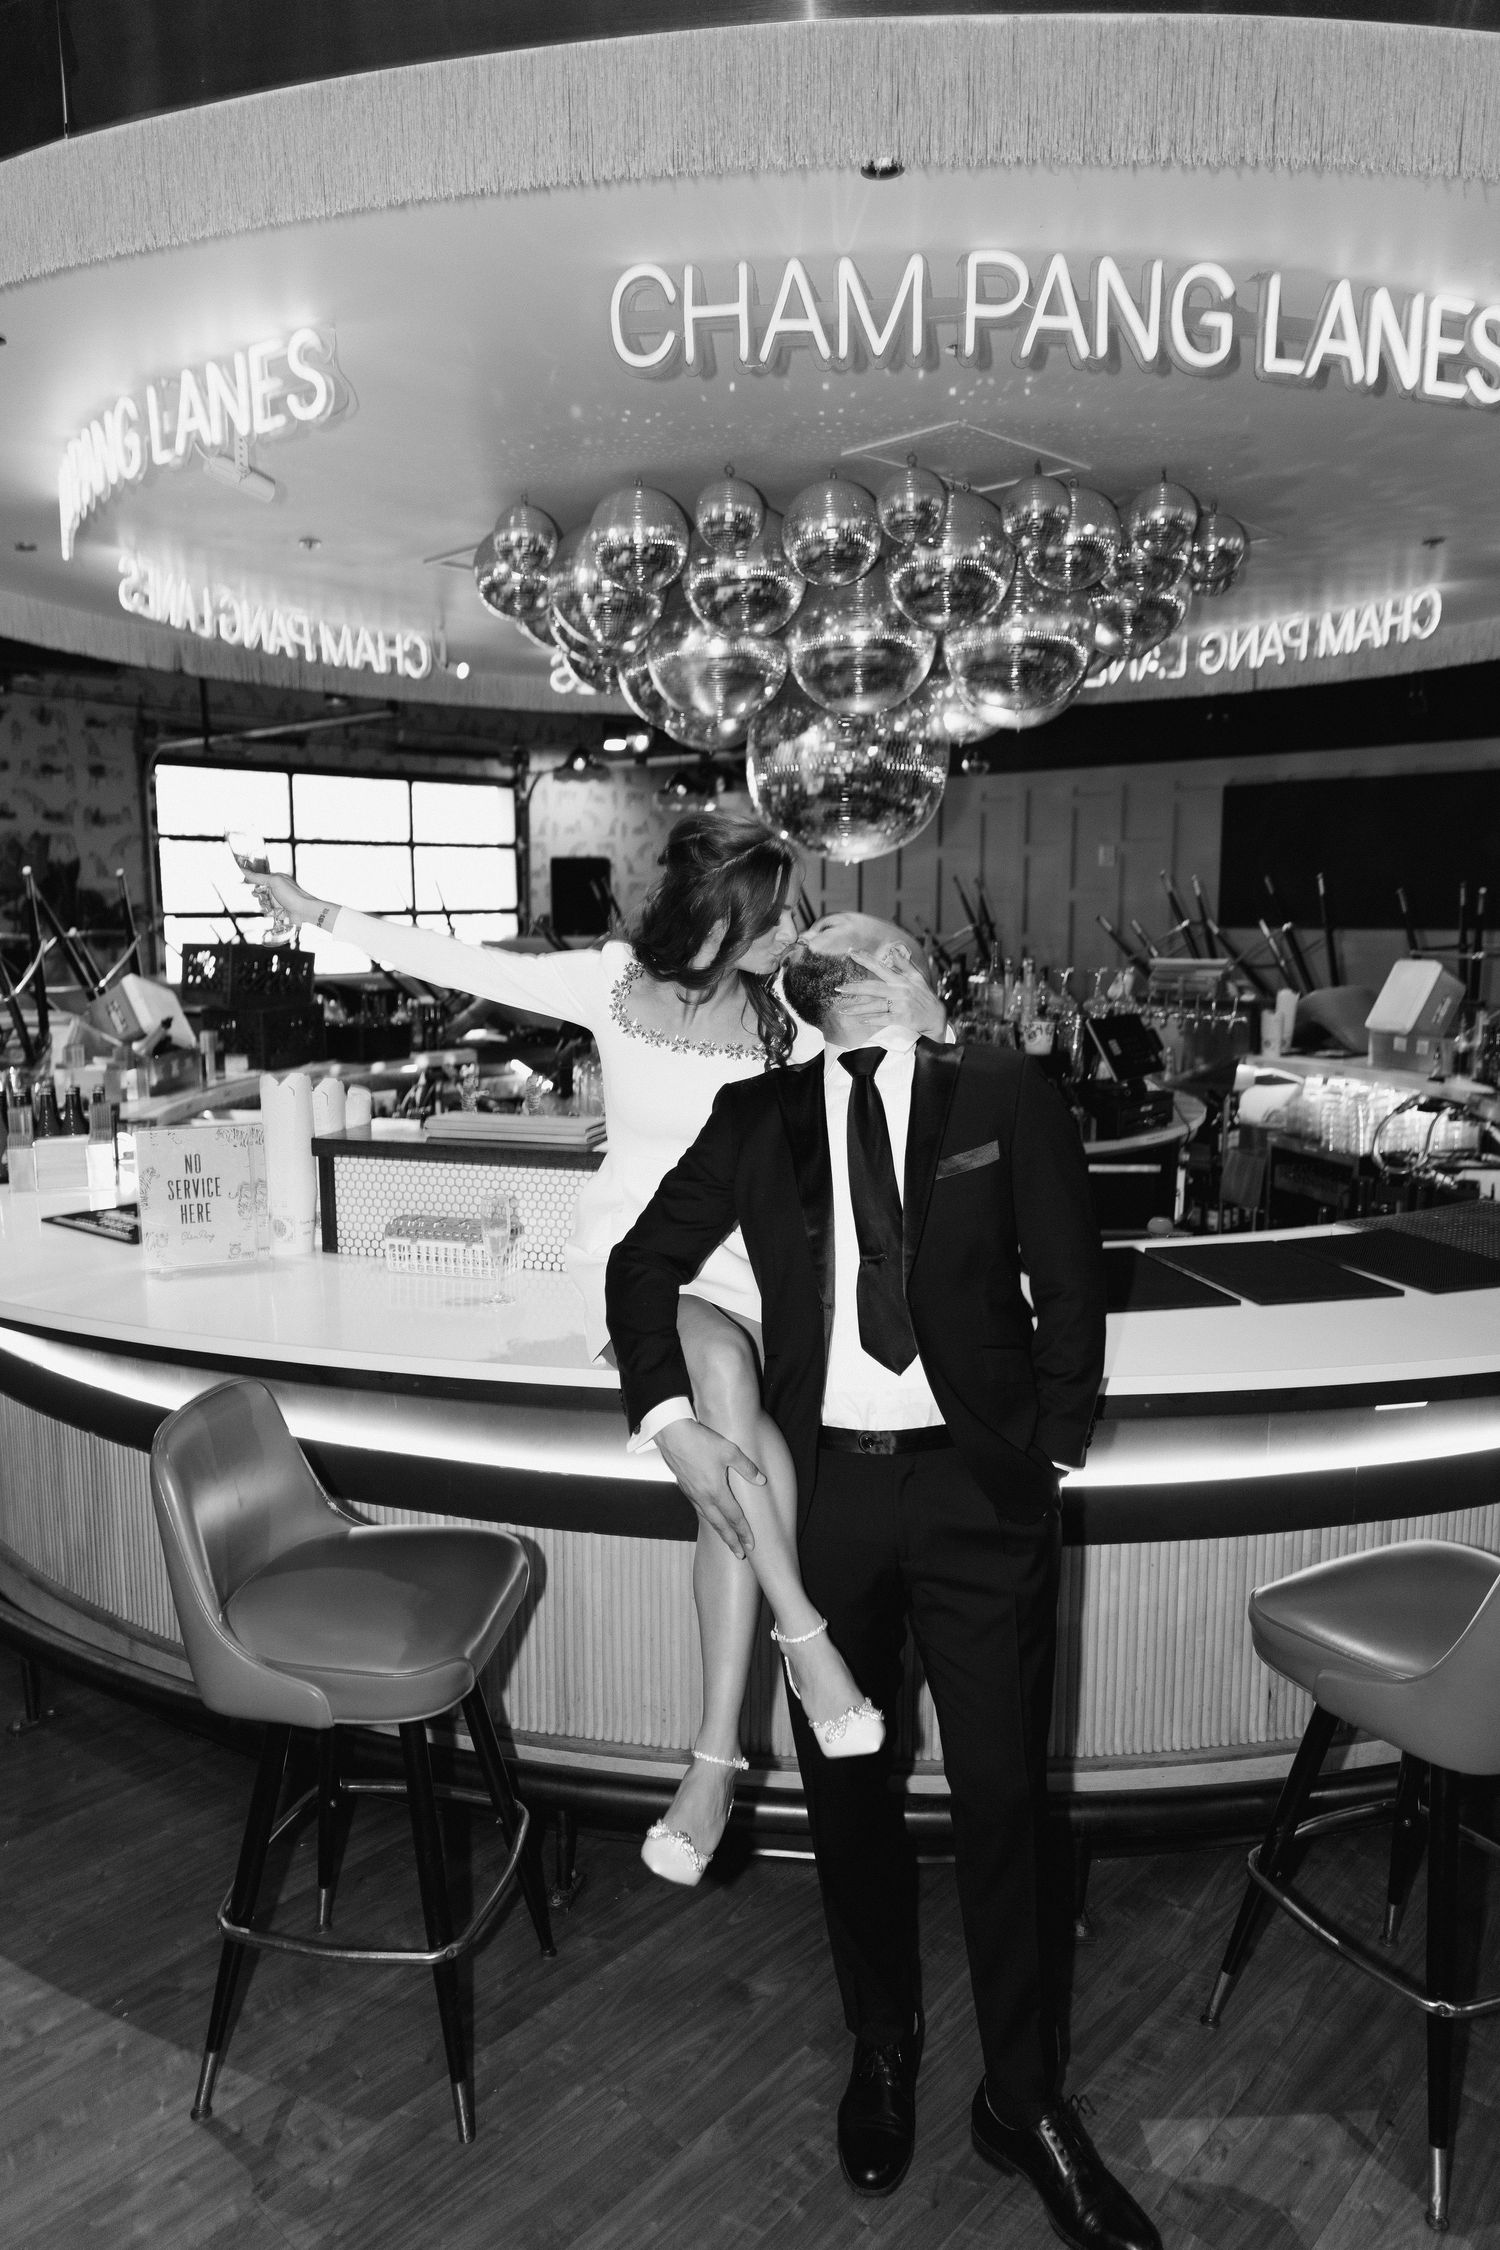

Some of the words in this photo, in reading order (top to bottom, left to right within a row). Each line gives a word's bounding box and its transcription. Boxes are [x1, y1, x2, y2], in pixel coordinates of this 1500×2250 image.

[609, 253, 925, 368] CHAM
[962, 249, 1235, 367] PANG
[1257, 271, 1500, 406] LANES
[145, 328, 329, 465] LANES
[184, 1153, 202, 1175] NO
[167, 1176, 222, 1201] SERVICE
[180, 1202, 213, 1225] HERE
